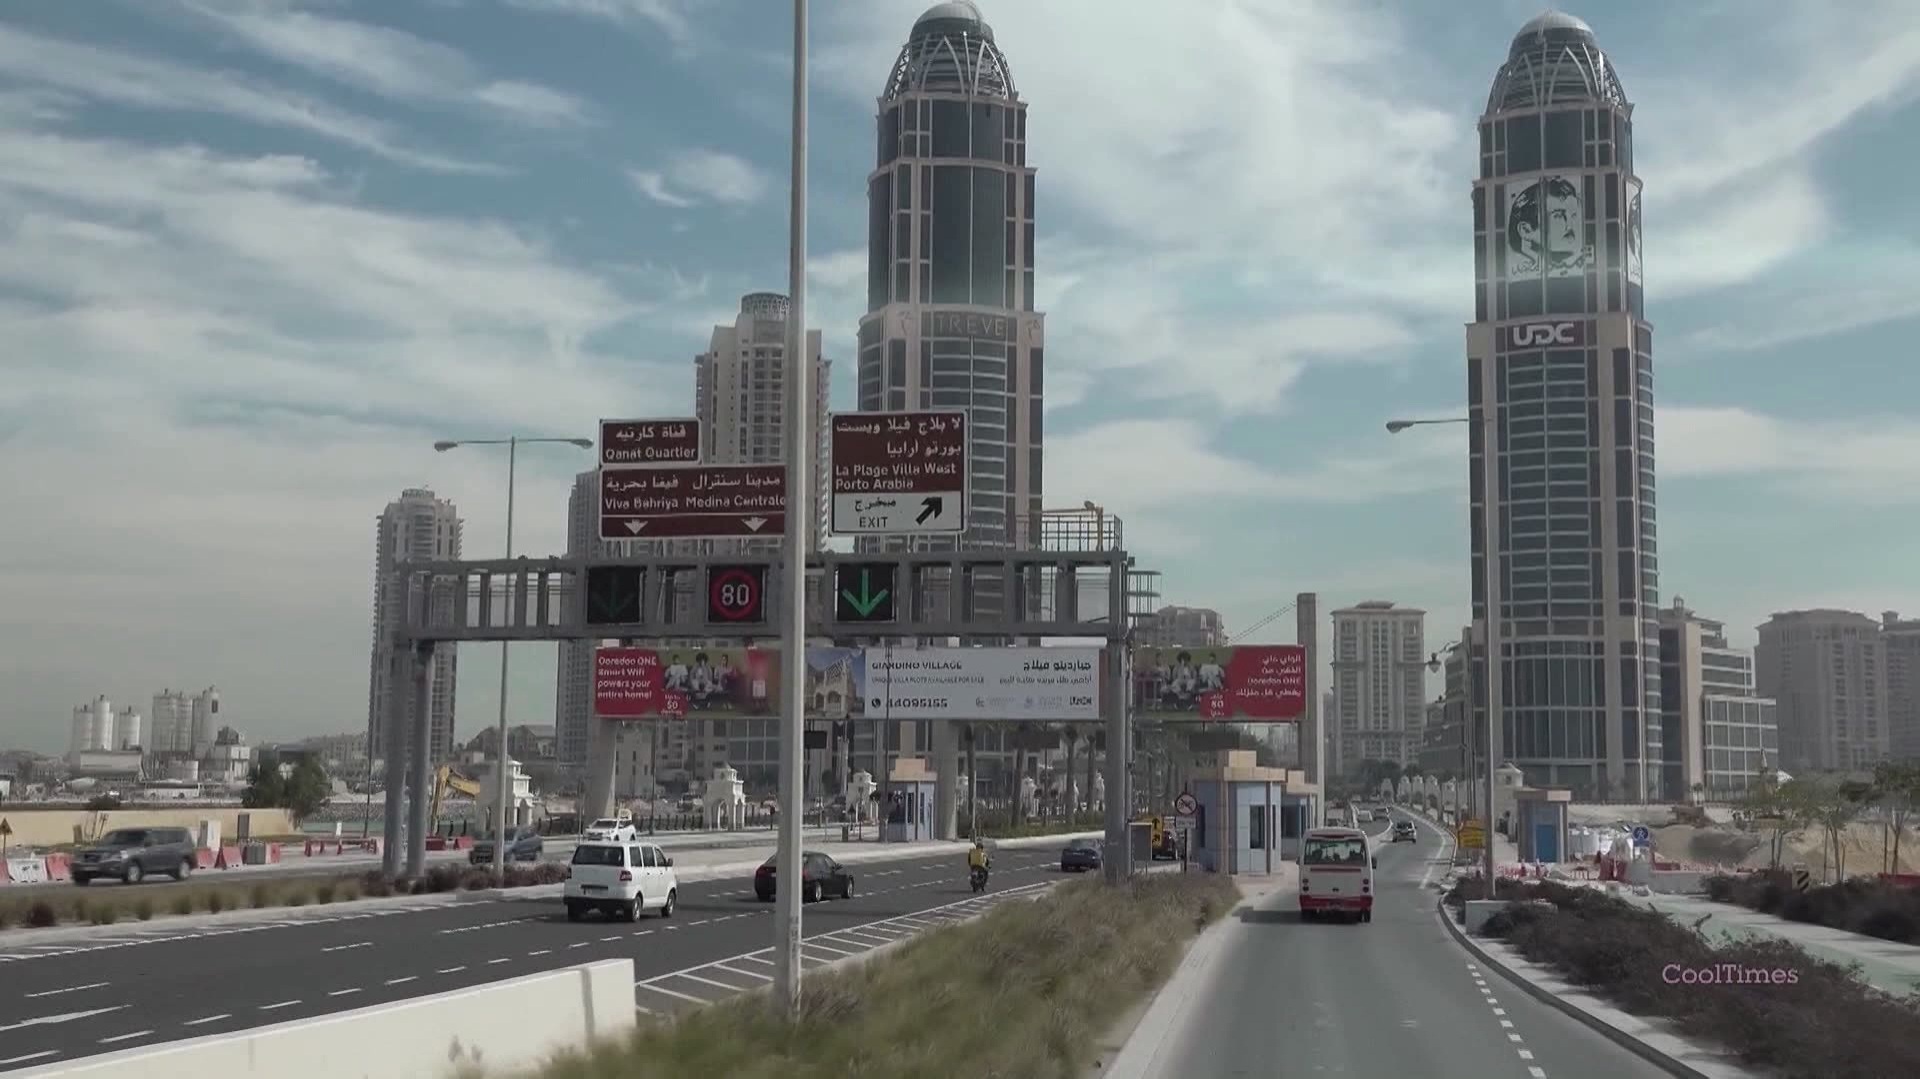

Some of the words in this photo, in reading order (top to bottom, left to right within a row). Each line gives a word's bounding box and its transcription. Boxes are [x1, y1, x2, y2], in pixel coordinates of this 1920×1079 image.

[1512, 323, 1575, 346] UDC
[836, 422, 880, 434] ويست
[887, 416, 911, 434] فيلا
[918, 416, 946, 435] بلاج
[951, 415, 961, 429] لا
[616, 425, 654, 441] كارتيه
[662, 424, 686, 438] قناة
[606, 447, 641, 460] Qanat
[645, 445, 696, 459] Quartier
[925, 441, 961, 457] بورتو
[835, 465, 849, 477] La
[853, 464, 889, 477] Plage
[892, 463, 920, 475] Villa
[924, 462, 956, 475] West
[606, 477, 647, 492] بحرية
[692, 474, 741, 490] سنترال
[835, 478, 869, 490] Porto
[873, 478, 914, 490] Arabia
[605, 497, 630, 509] Viva
[633, 497, 679, 510] Bahriya
[686, 495, 730, 508] Medina
[855, 497, 896, 512] مخرج
[859, 516, 888, 528] EXIT
[721, 584, 750, 605] 80
[598, 656, 636, 666] Ooredoo
[637, 656, 657, 666] ONE
[922, 662, 962, 670] VILLAGE
[597, 680, 630, 689] powers
[631, 680, 651, 689] your
